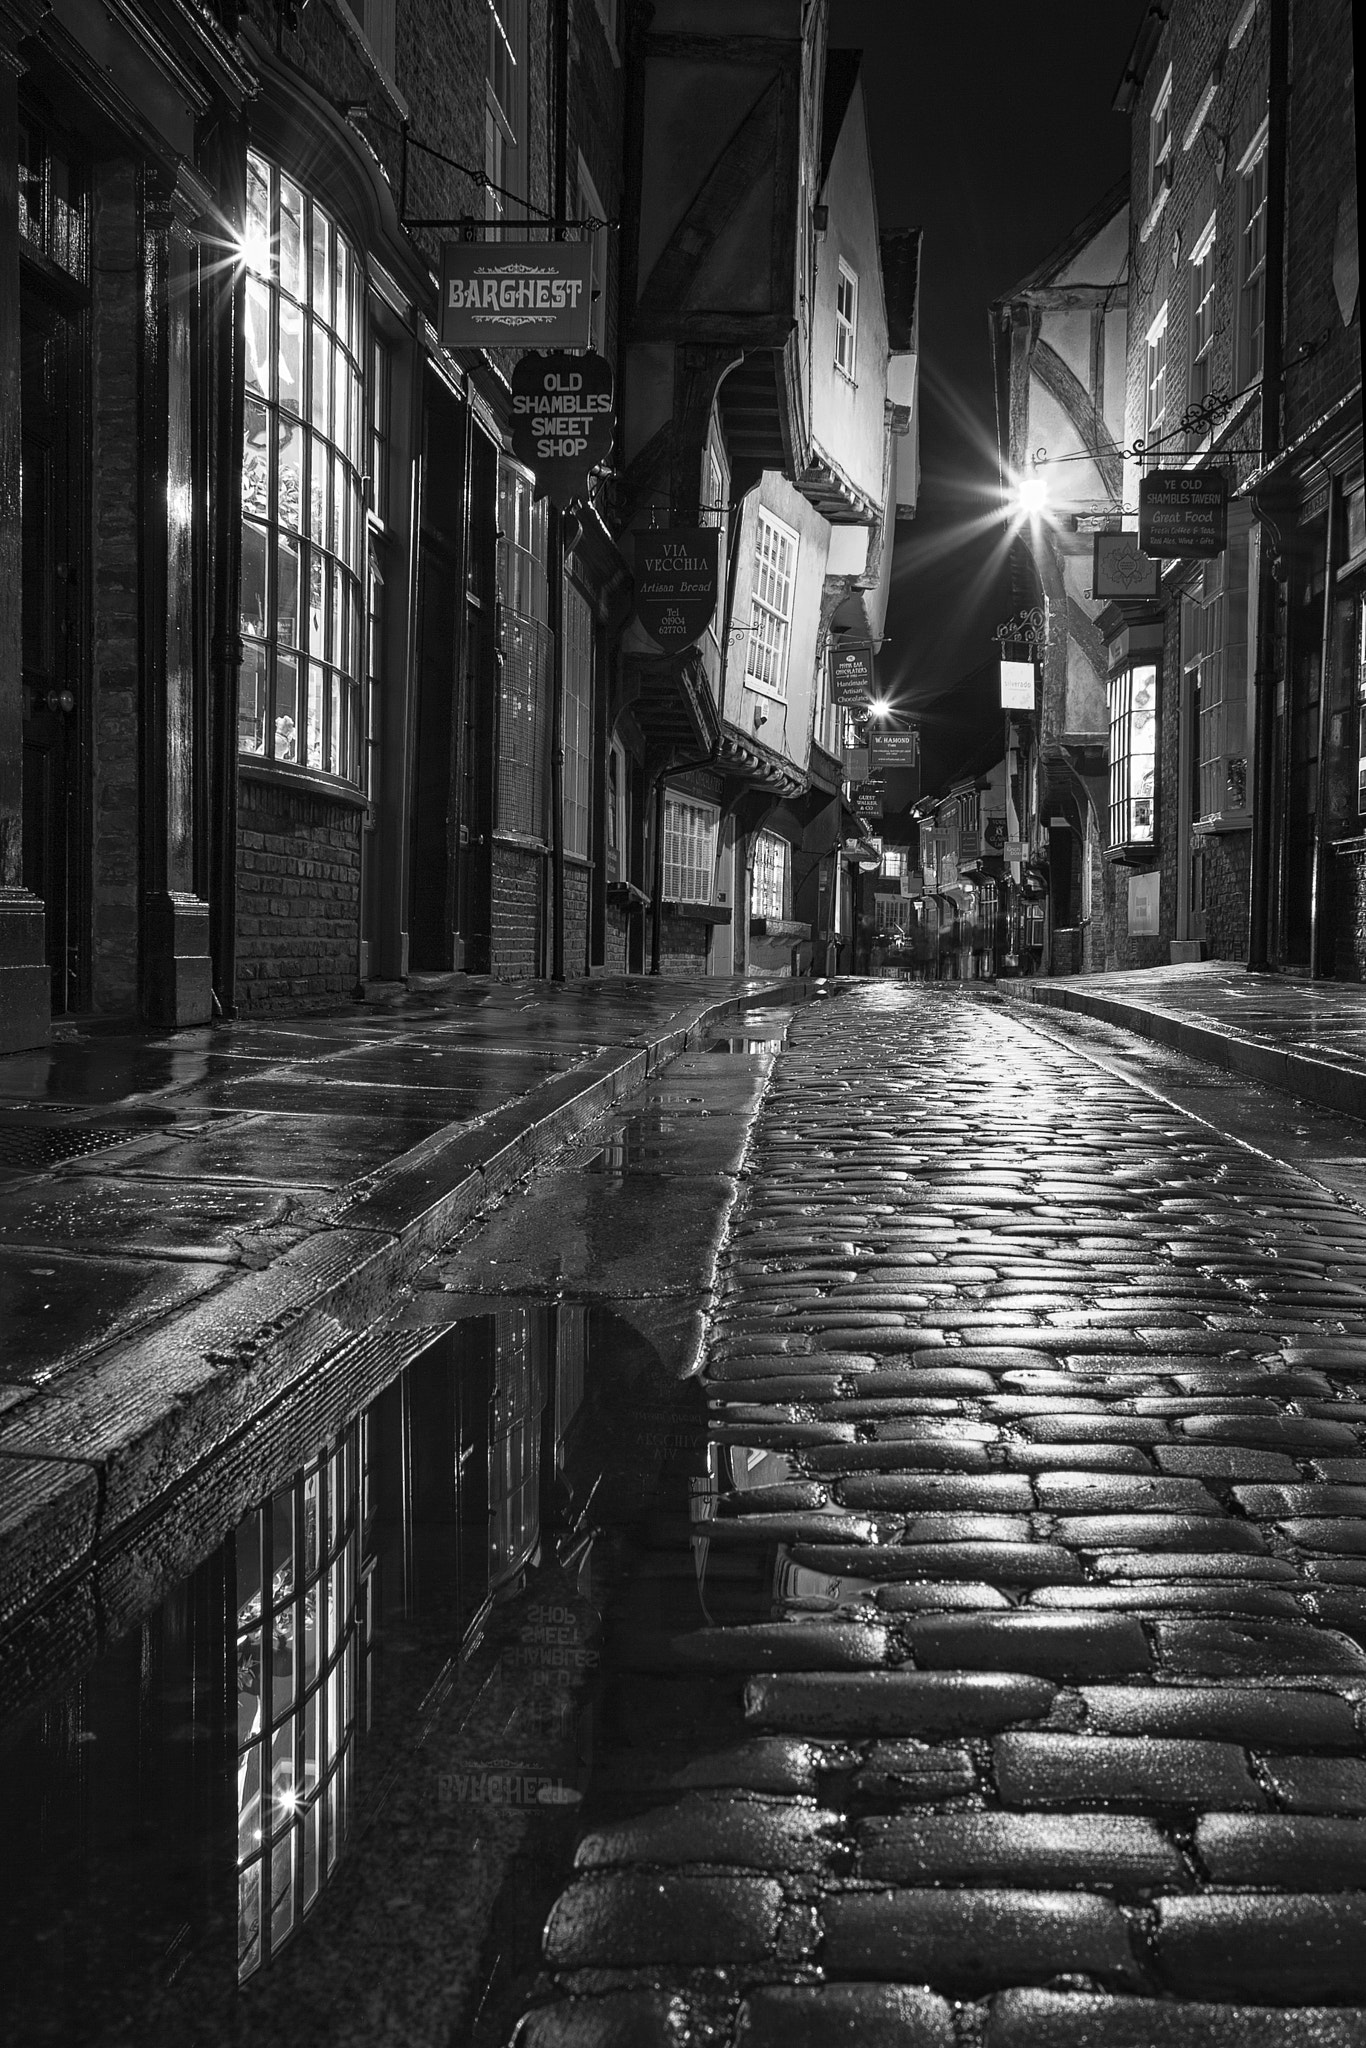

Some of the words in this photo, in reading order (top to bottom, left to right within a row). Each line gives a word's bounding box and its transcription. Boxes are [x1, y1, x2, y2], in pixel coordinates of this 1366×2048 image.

[448, 279, 582, 311] BARGHEST
[543, 372, 583, 391] OLD
[512, 394, 611, 414] SHAMBLES
[531, 416, 593, 436] SWEET
[537, 438, 588, 458] SHOP
[1164, 480, 1176, 490] YE
[1180, 480, 1203, 490] OLD
[1147, 493, 1190, 505] SHAMBLES
[1191, 493, 1221, 505] TAVERN
[1152, 511, 1181, 523] Great
[1185, 510, 1213, 523] Food
[662, 544, 688, 557] VIA
[645, 558, 709, 572] VECCHIA
[640, 582, 674, 593] Artisan
[679, 581, 712, 592] Bread
[666, 608, 680, 617] Tel
[661, 617, 685, 625] 01904
[659, 626, 687, 634] 627701
